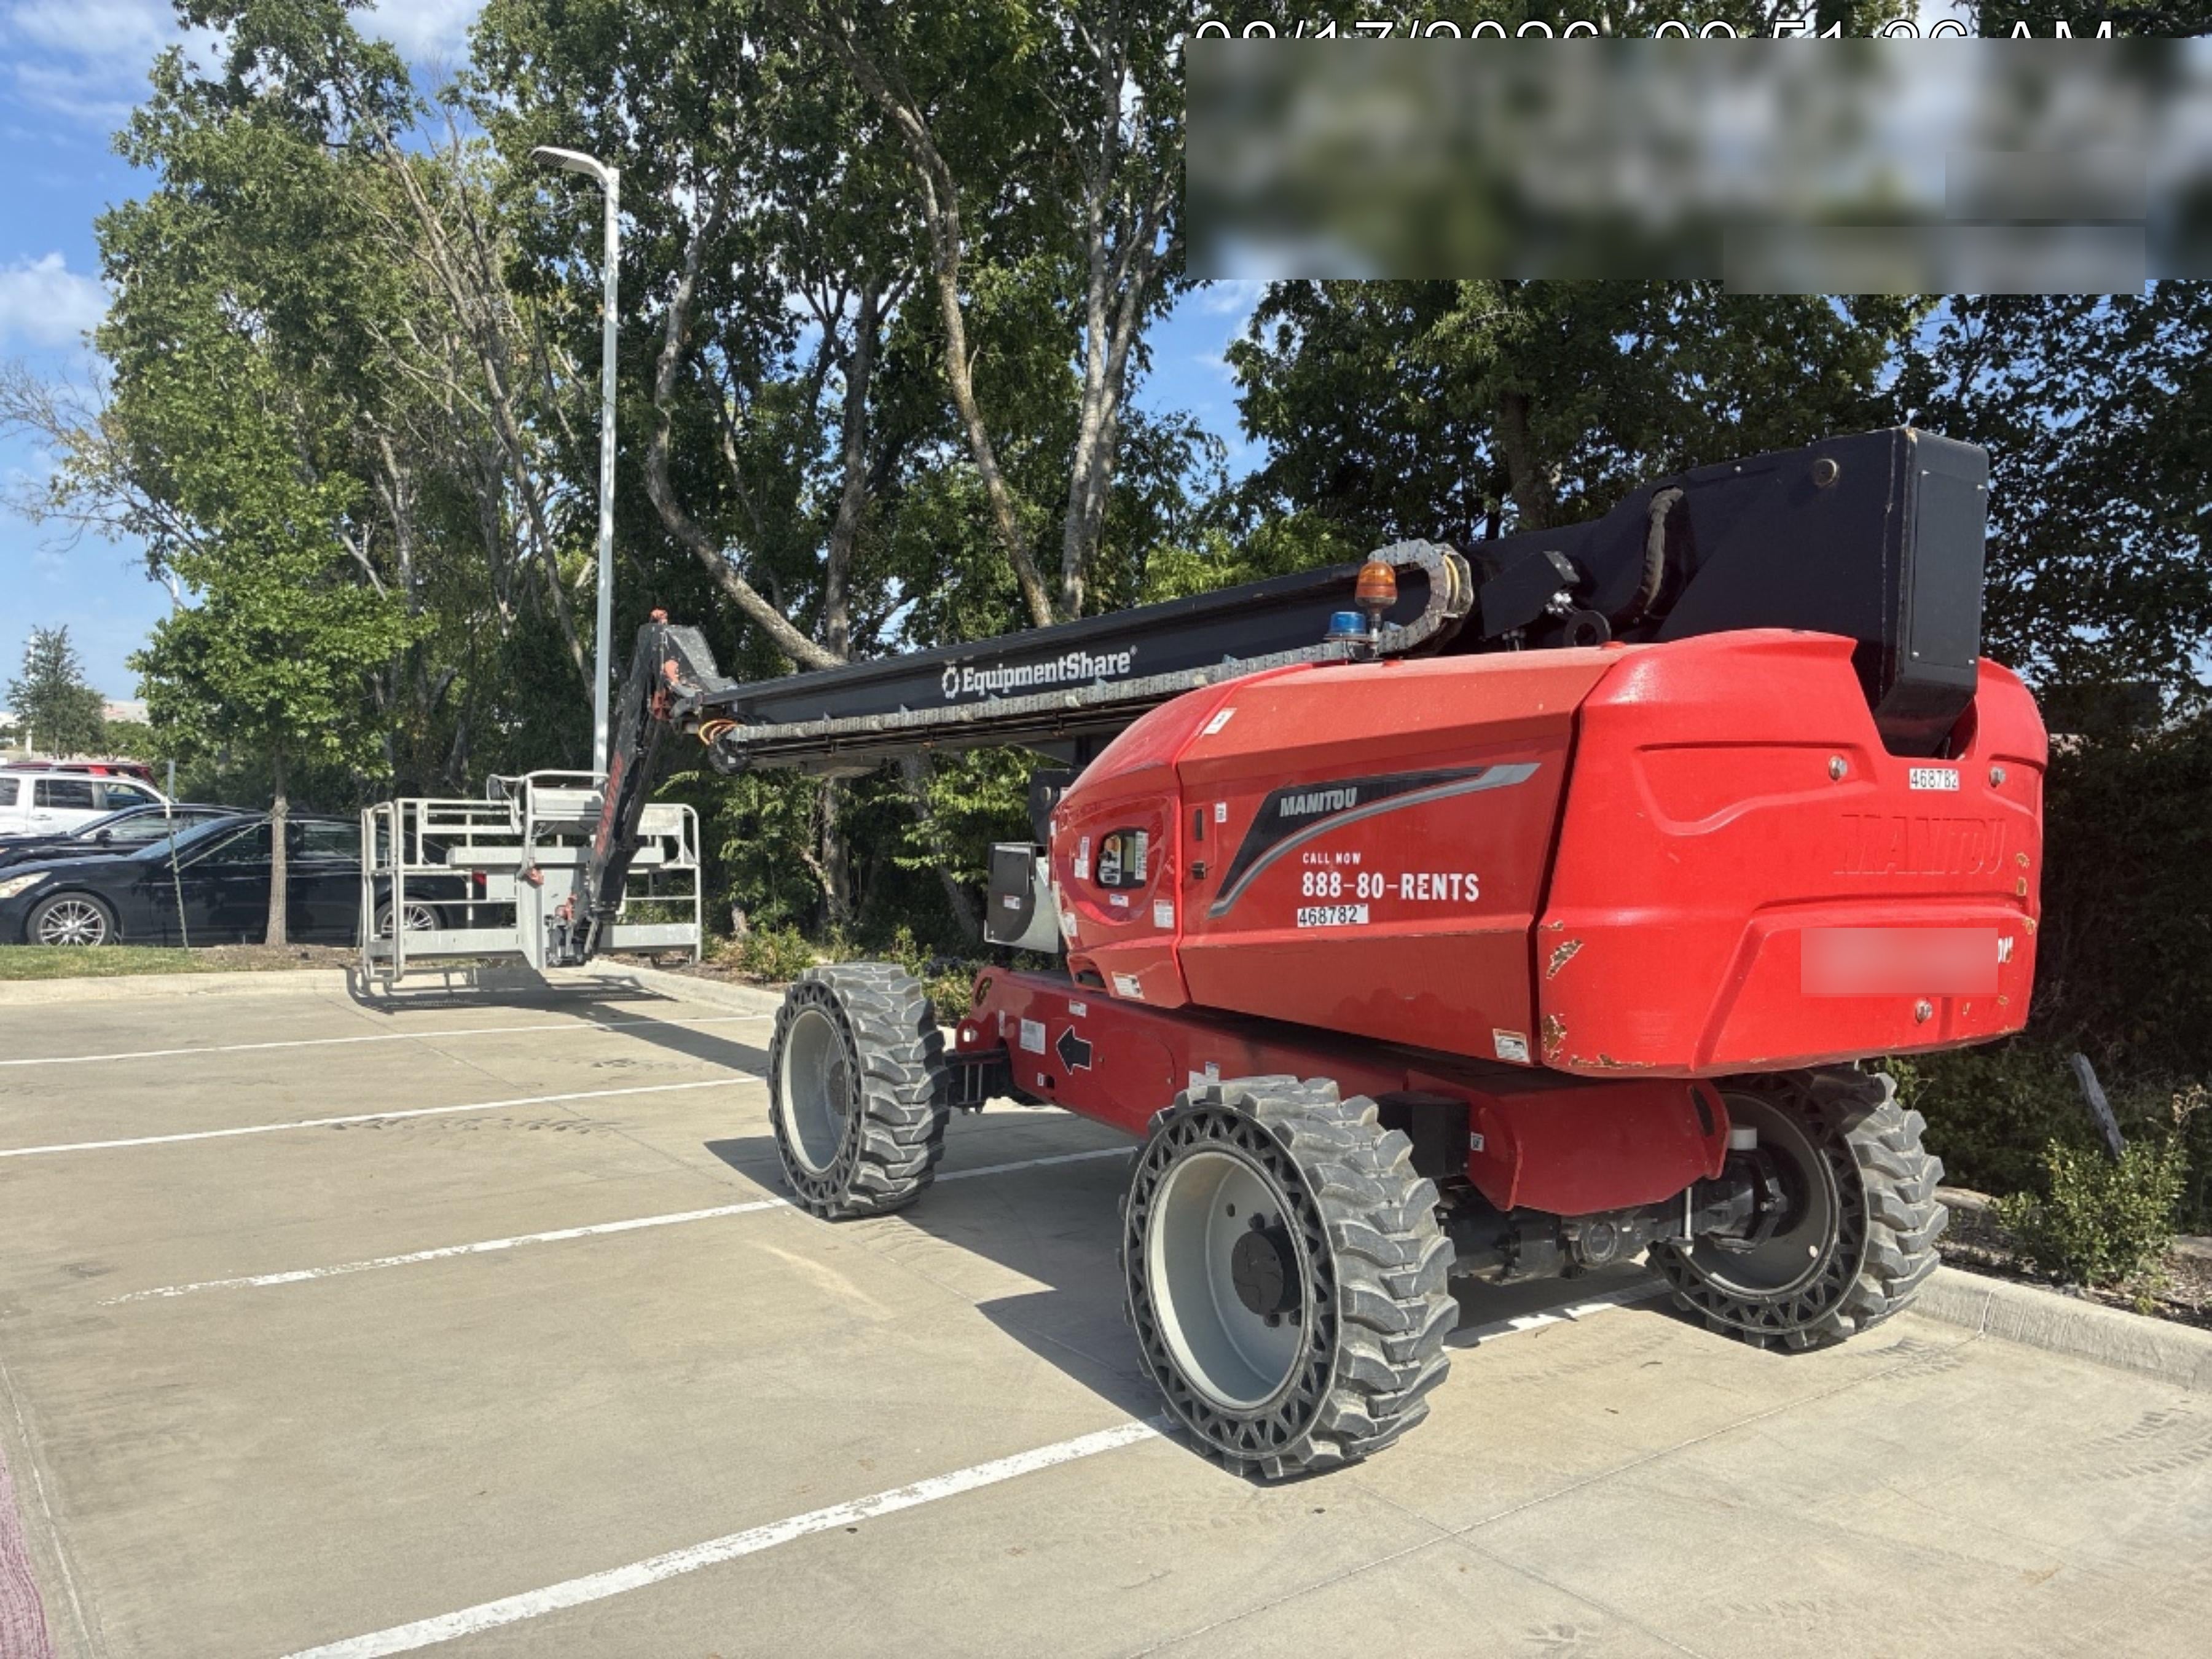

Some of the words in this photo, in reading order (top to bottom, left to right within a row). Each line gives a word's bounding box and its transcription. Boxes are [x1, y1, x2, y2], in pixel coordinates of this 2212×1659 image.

[1912, 769, 1957, 788] 468782
[1280, 786, 1357, 817] MANITOU
[1303, 852, 1330, 864] CALL
[1336, 852, 1361, 864] NOW
[1302, 871, 1480, 902] 888-80-RENTS
[1299, 906, 1358, 925] 468782
